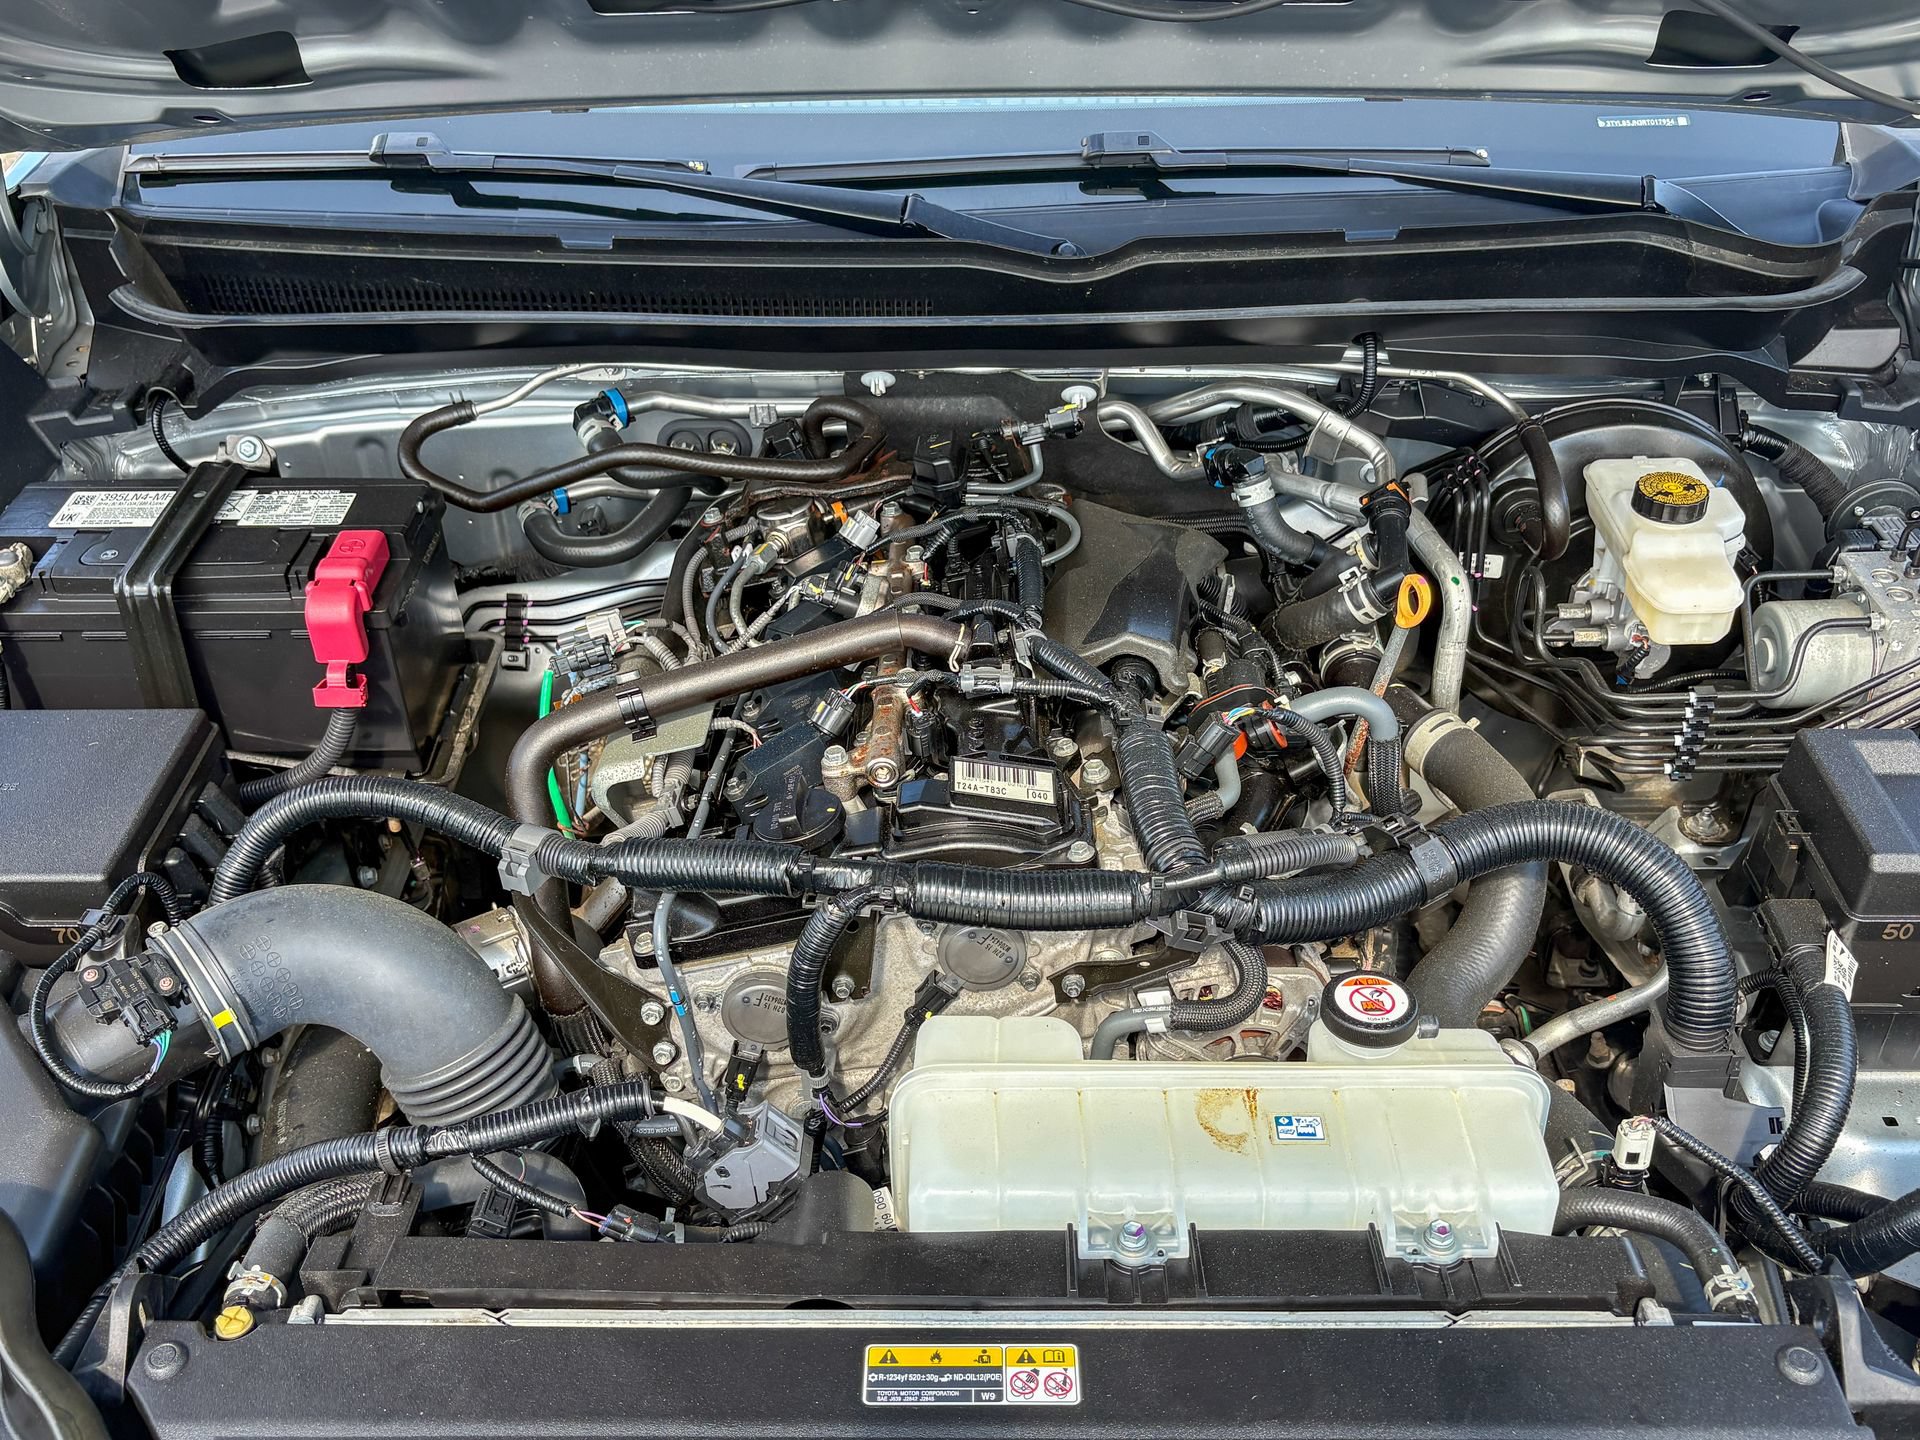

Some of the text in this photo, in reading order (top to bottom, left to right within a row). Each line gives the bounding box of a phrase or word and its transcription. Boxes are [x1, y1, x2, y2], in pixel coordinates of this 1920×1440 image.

[956, 782, 1007, 796] T24A-T83C
[1031, 791, 1048, 801] 040
[51, 927, 81, 944] 70
[1882, 923, 1915, 940] 50
[878, 1373, 1003, 1383] R-1234yf 520±30g ND-OIL12(POE)
[981, 1392, 996, 1401] W9
